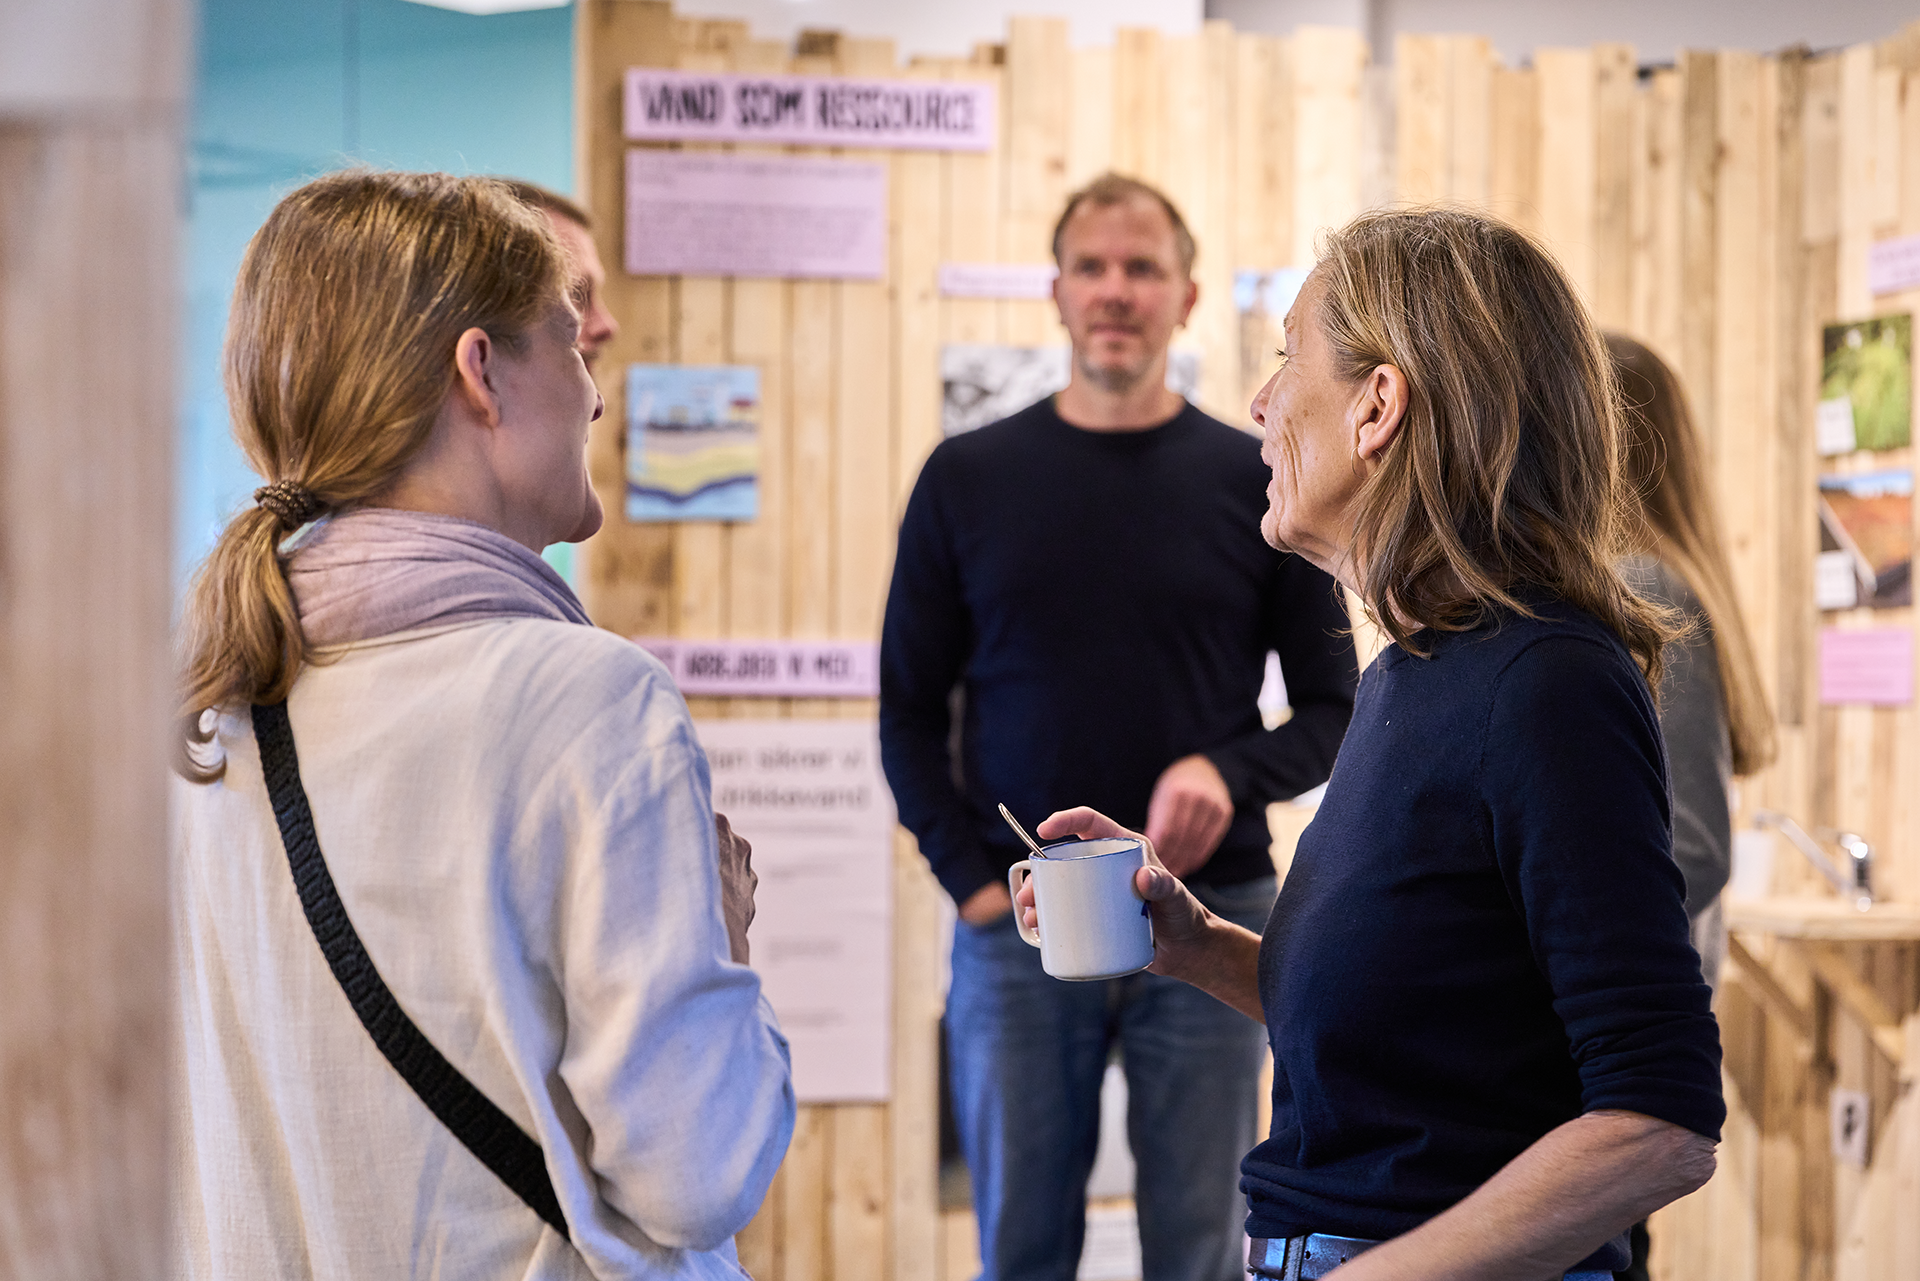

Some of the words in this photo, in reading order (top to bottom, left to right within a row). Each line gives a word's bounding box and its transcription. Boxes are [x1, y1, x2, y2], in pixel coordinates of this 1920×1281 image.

[638, 80, 724, 124] VAND
[735, 81, 806, 130] SOM
[814, 82, 977, 133] RESSOURCE
